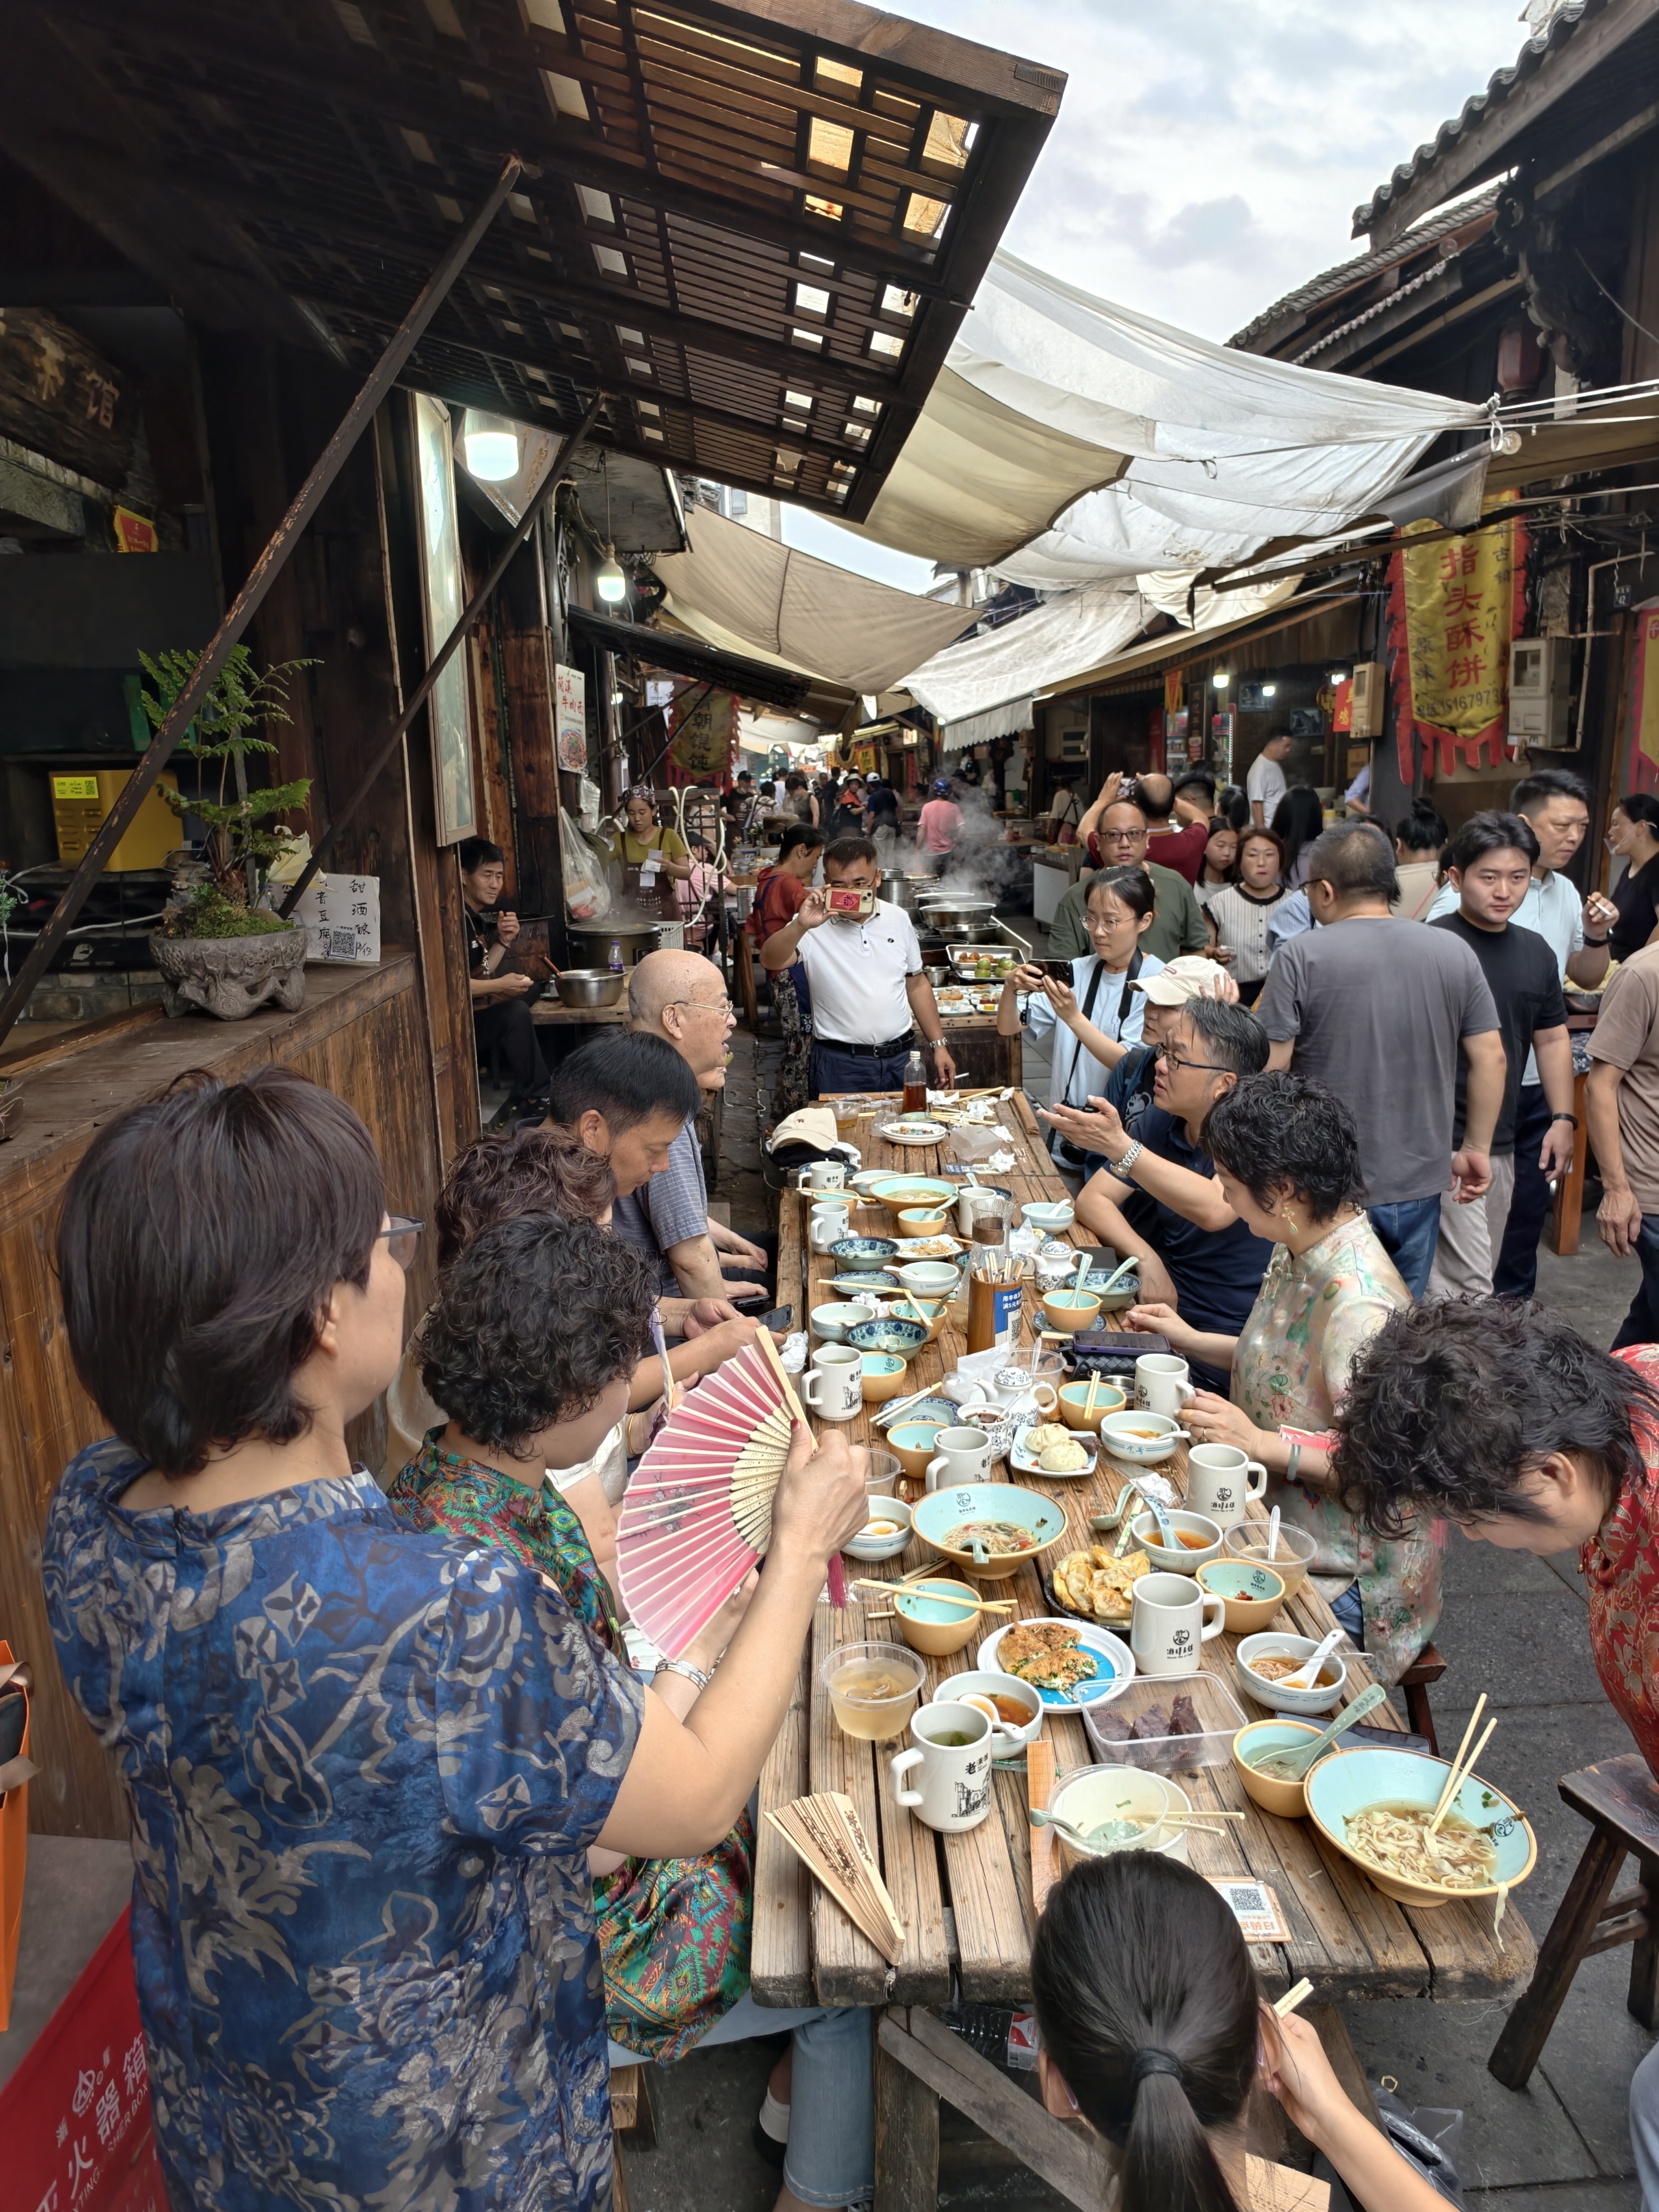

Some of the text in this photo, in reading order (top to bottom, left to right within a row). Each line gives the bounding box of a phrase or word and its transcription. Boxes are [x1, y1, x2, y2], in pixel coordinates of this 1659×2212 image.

[1439, 544, 1487, 689] 指头酥饼
[314, 880, 332, 940] 音豆腐
[349, 878, 372, 935] 甜酒酿
